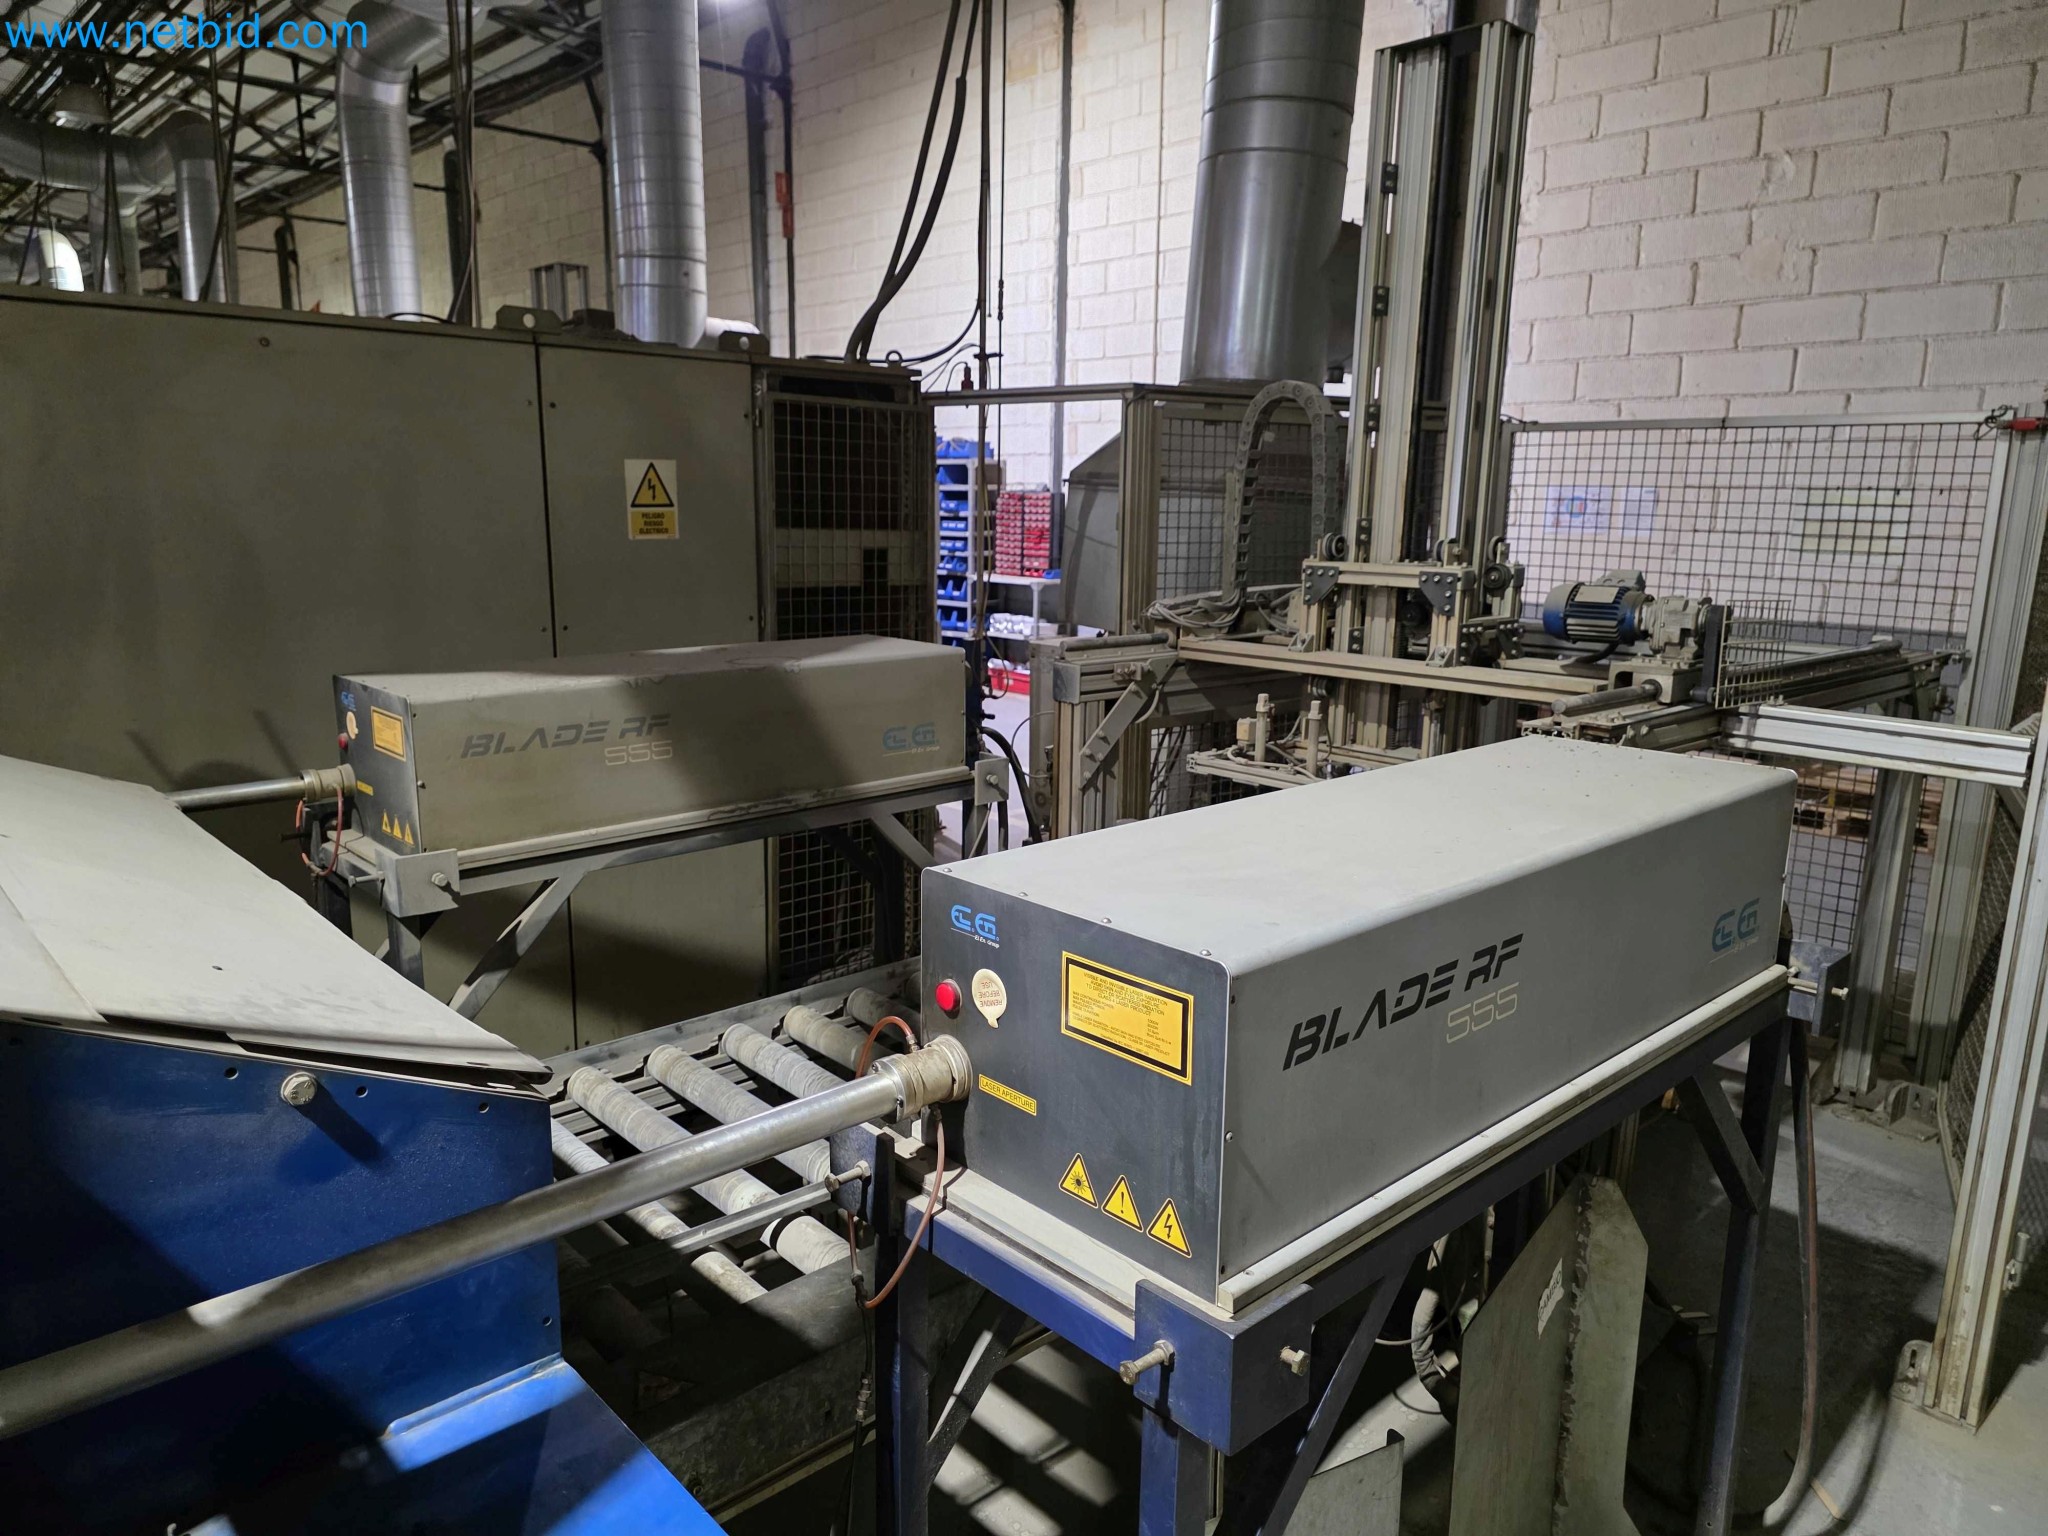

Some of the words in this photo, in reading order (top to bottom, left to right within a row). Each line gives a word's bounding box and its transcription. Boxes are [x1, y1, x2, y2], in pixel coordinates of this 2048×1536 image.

[460, 720, 611, 759] BLADE
[618, 713, 672, 740] RF
[978, 990, 1000, 999] BEFORE
[979, 999, 1003, 1007] REMOVE
[1282, 959, 1459, 1071] BLADE
[1464, 933, 1523, 992] RF
[982, 1081, 1001, 1094] LASER
[1001, 1089, 1035, 1111] APERTURE
